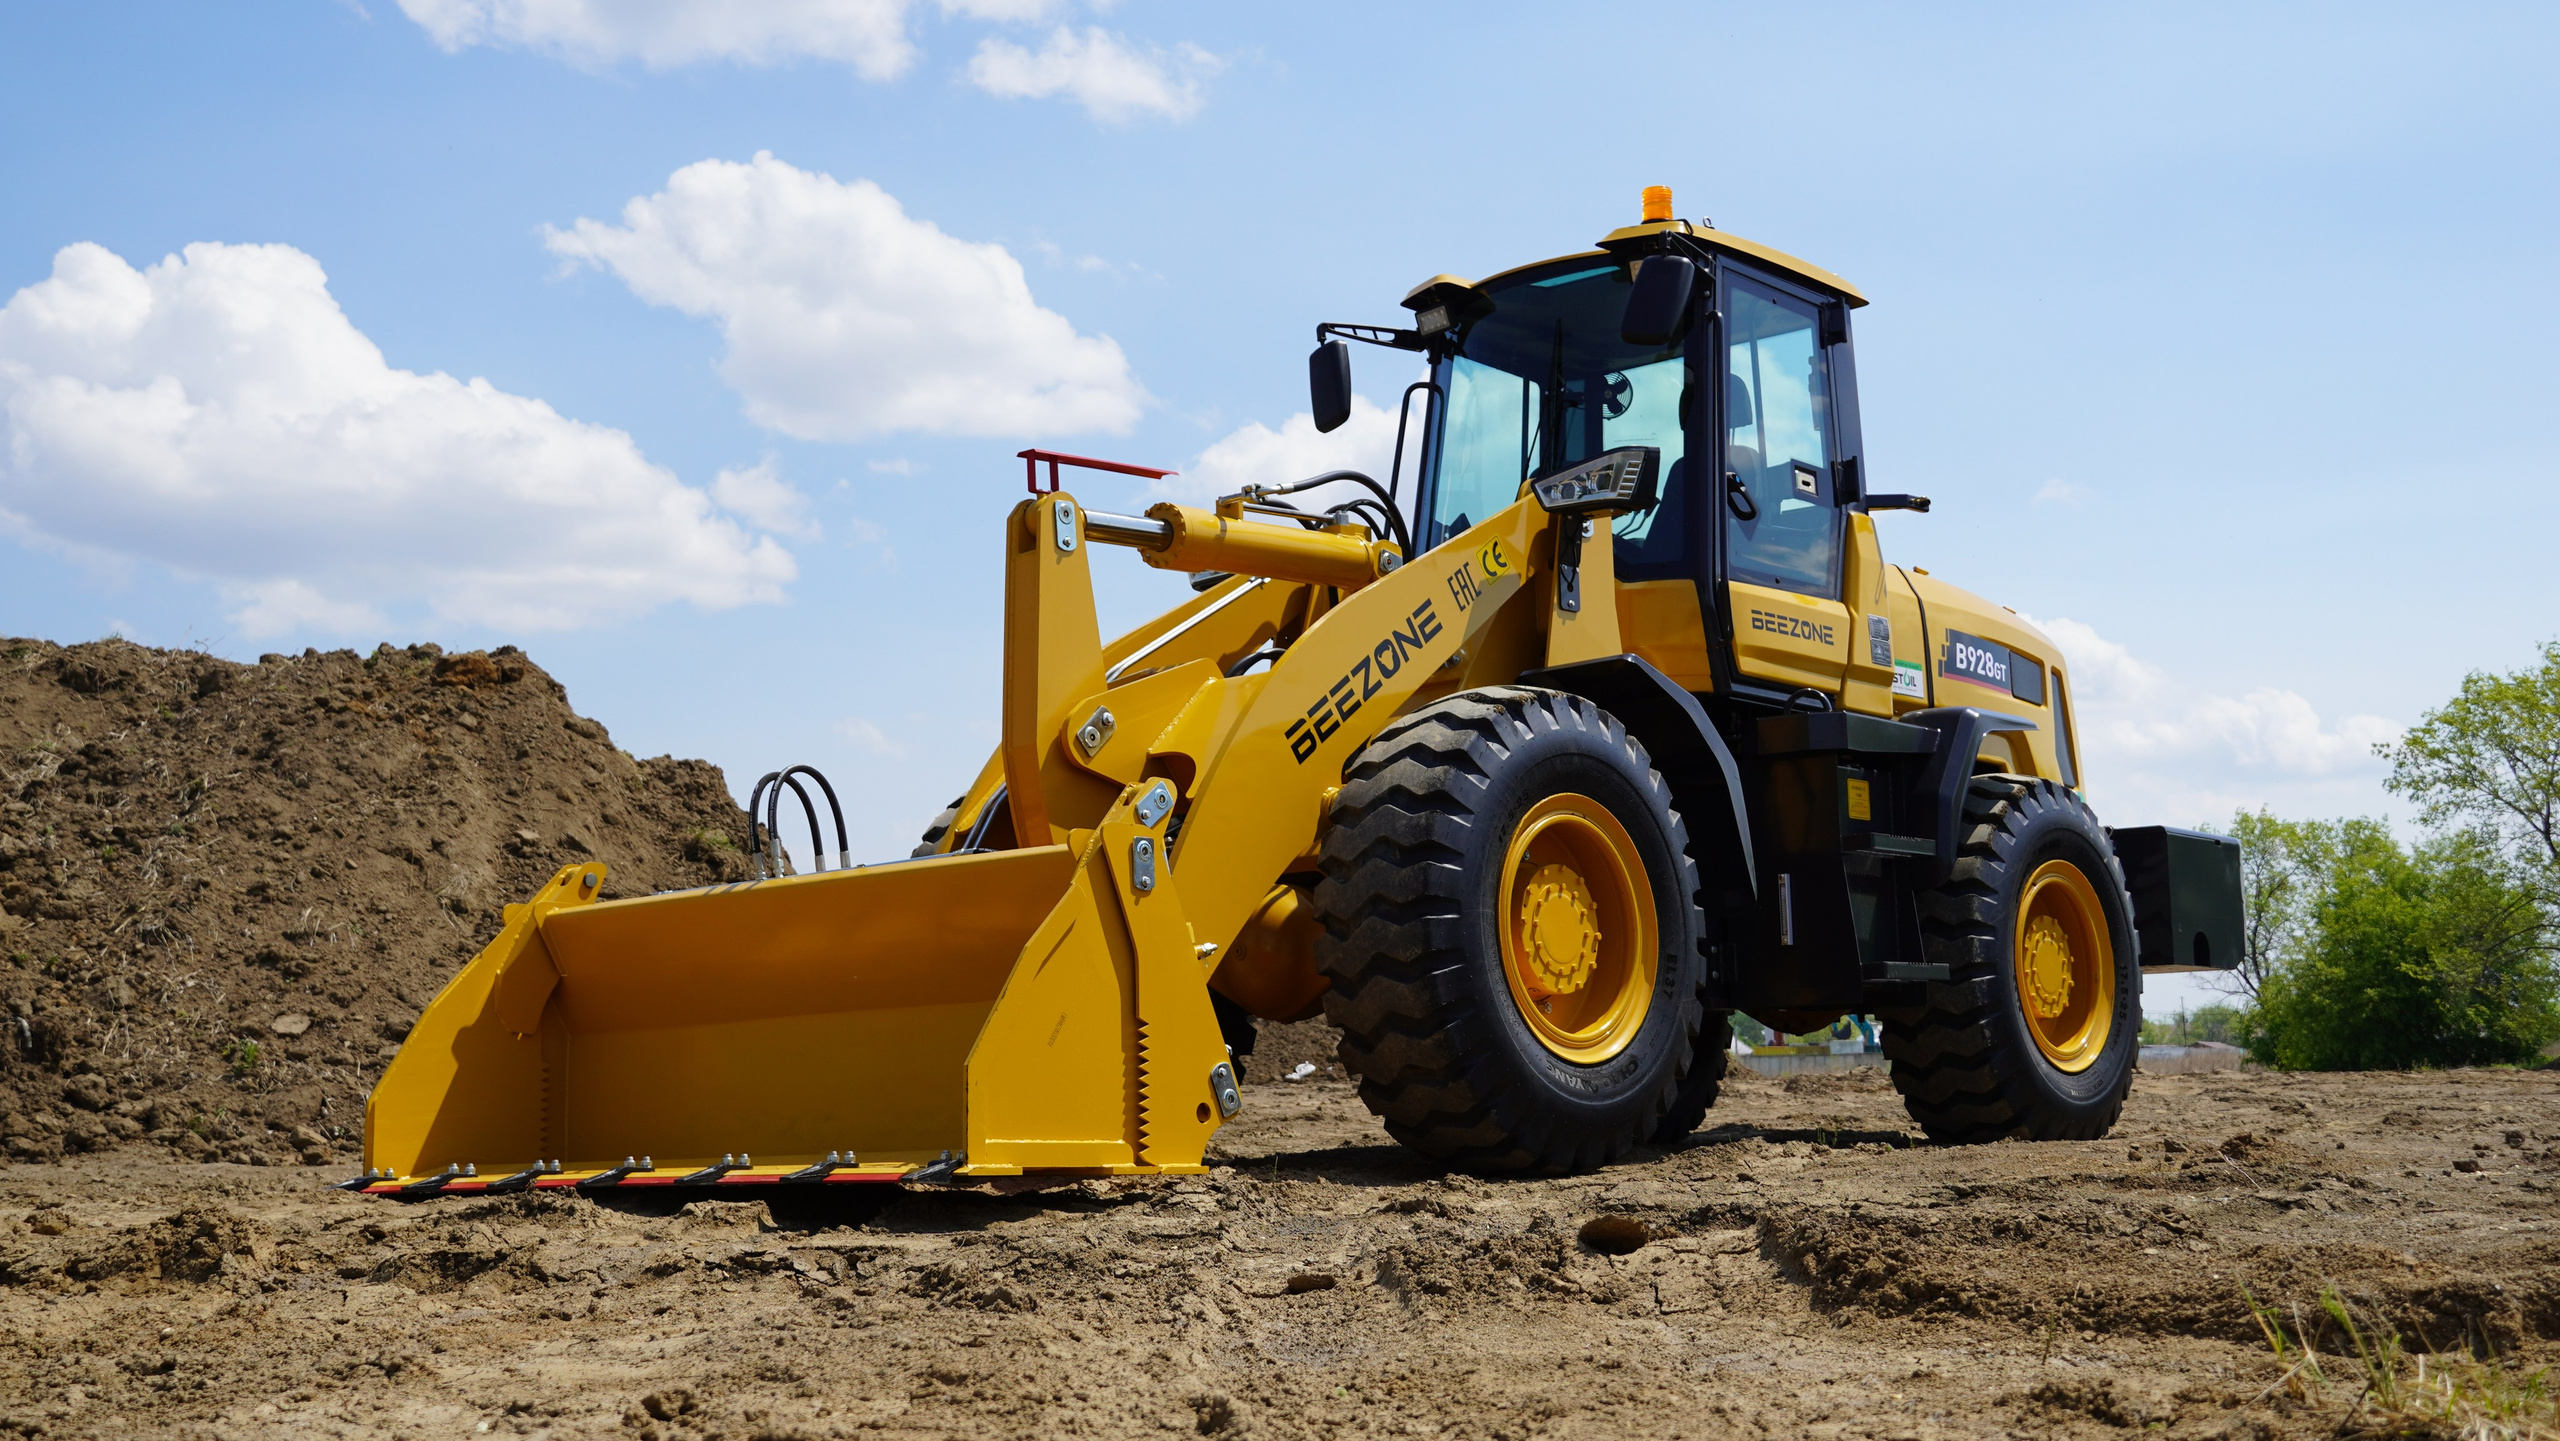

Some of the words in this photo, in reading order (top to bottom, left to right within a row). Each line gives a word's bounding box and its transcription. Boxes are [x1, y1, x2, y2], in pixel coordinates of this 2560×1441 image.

[1482, 540, 1508, 577] CE
[1751, 609, 1834, 646] BEEZONE
[1284, 597, 1443, 765] BEEZONE
